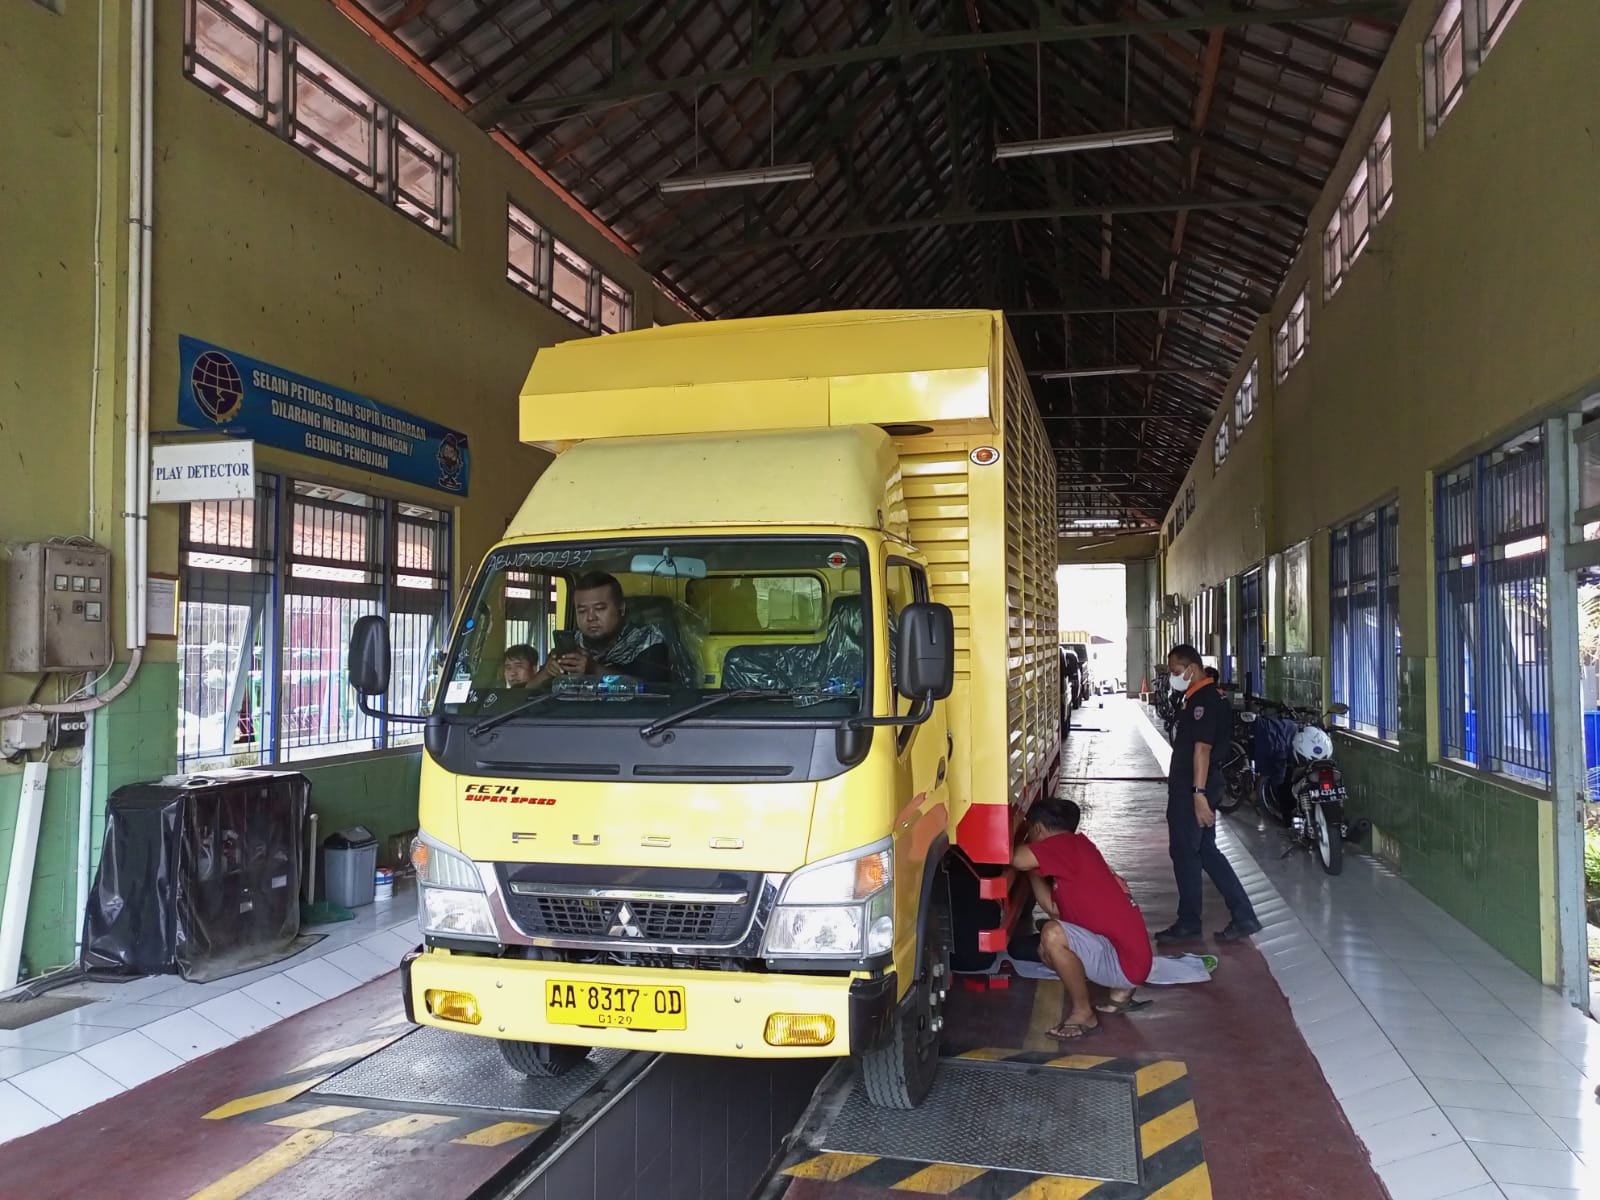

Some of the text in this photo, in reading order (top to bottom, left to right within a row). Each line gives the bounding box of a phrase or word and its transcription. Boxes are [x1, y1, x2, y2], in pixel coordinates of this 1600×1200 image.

[253, 369, 289, 397] SELAIN
[290, 382, 334, 411] PETUGAS
[335, 397, 353, 417] DAN
[354, 406, 380, 426] SUPIR
[271, 399, 321, 428] DILARANG
[322, 415, 371, 444] MEMASUKI
[371, 432, 408, 456] RUANGAN
[305, 432, 388, 469] GEDUNG PENGUJIAN
[156, 462, 250, 481] PLAY DETECTOR
[465, 783, 519, 795] FE74
[465, 794, 557, 806] SUPER SPEED
[511, 831, 745, 850] FUSO
[549, 984, 577, 1009] AA
[588, 986, 640, 1013] 8317
